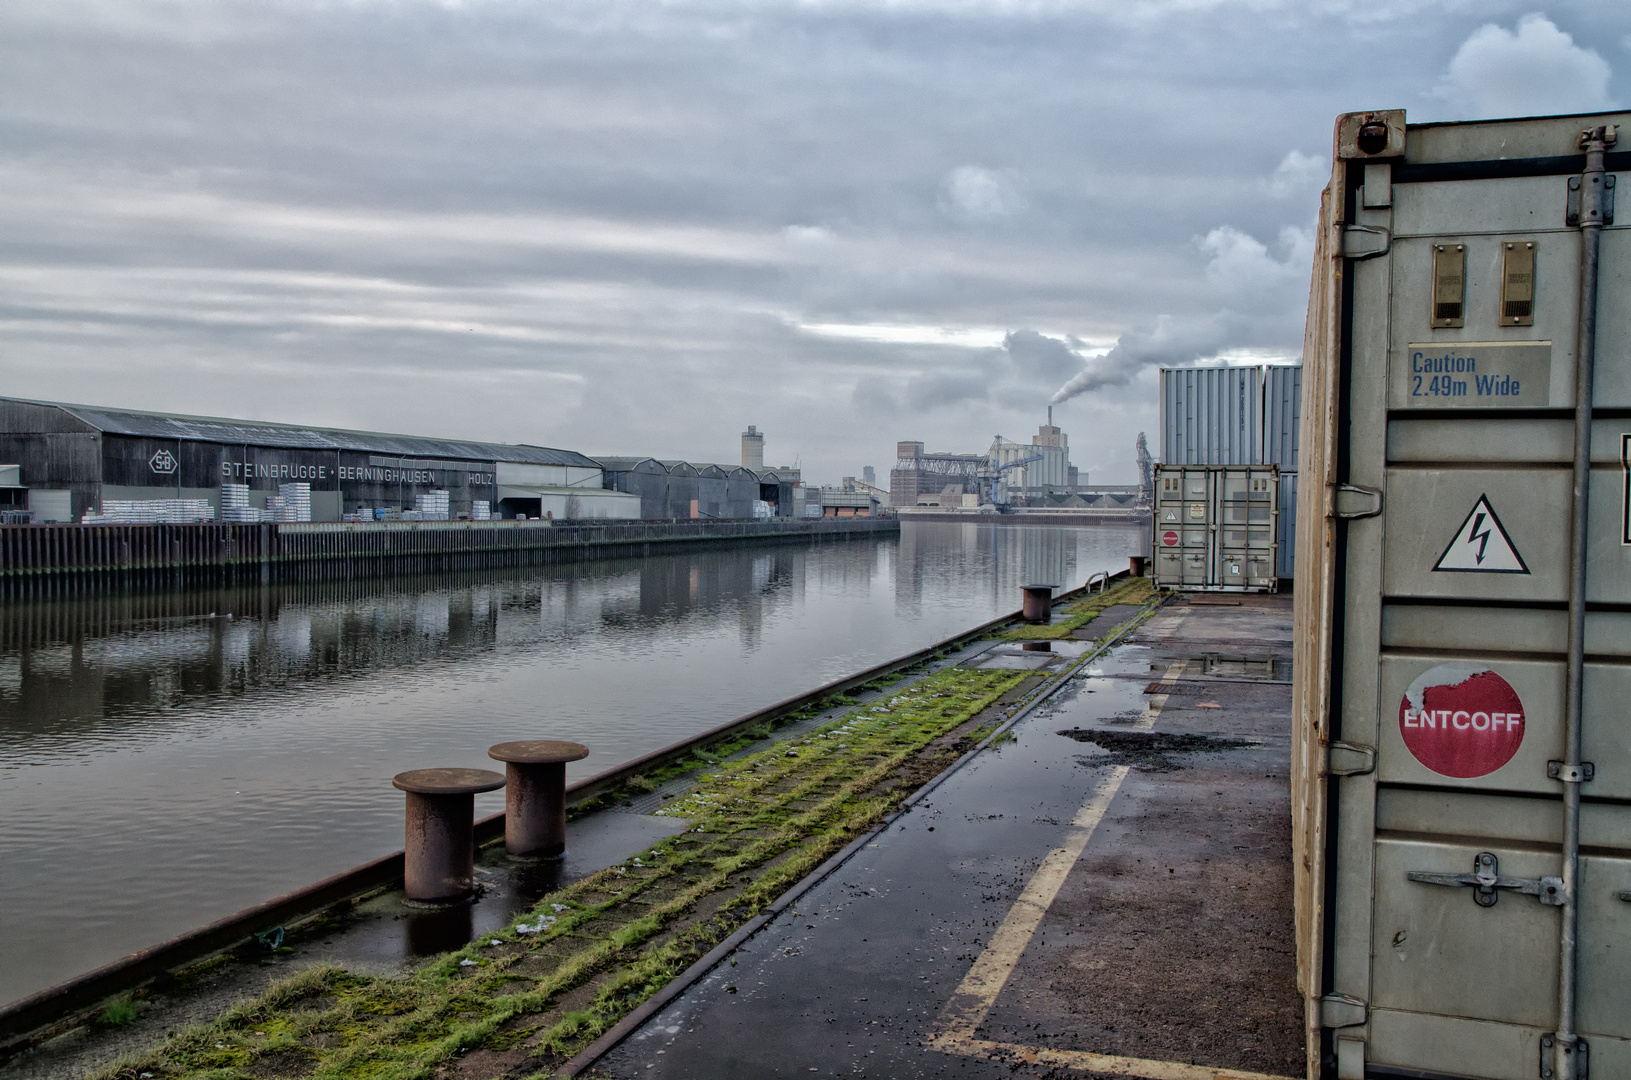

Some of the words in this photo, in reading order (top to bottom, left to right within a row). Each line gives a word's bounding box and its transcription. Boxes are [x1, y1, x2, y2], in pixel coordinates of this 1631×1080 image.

[1413, 352, 1476, 373] Caution
[1412, 375, 1467, 397] 2.49m
[1475, 374, 1520, 396] Wide
[222, 461, 326, 479] STEINBRÜGGE
[339, 466, 435, 483] BERNINGHAUSEN
[468, 472, 493, 485] HOLZ
[1404, 709, 1521, 732] ENTCOFF
